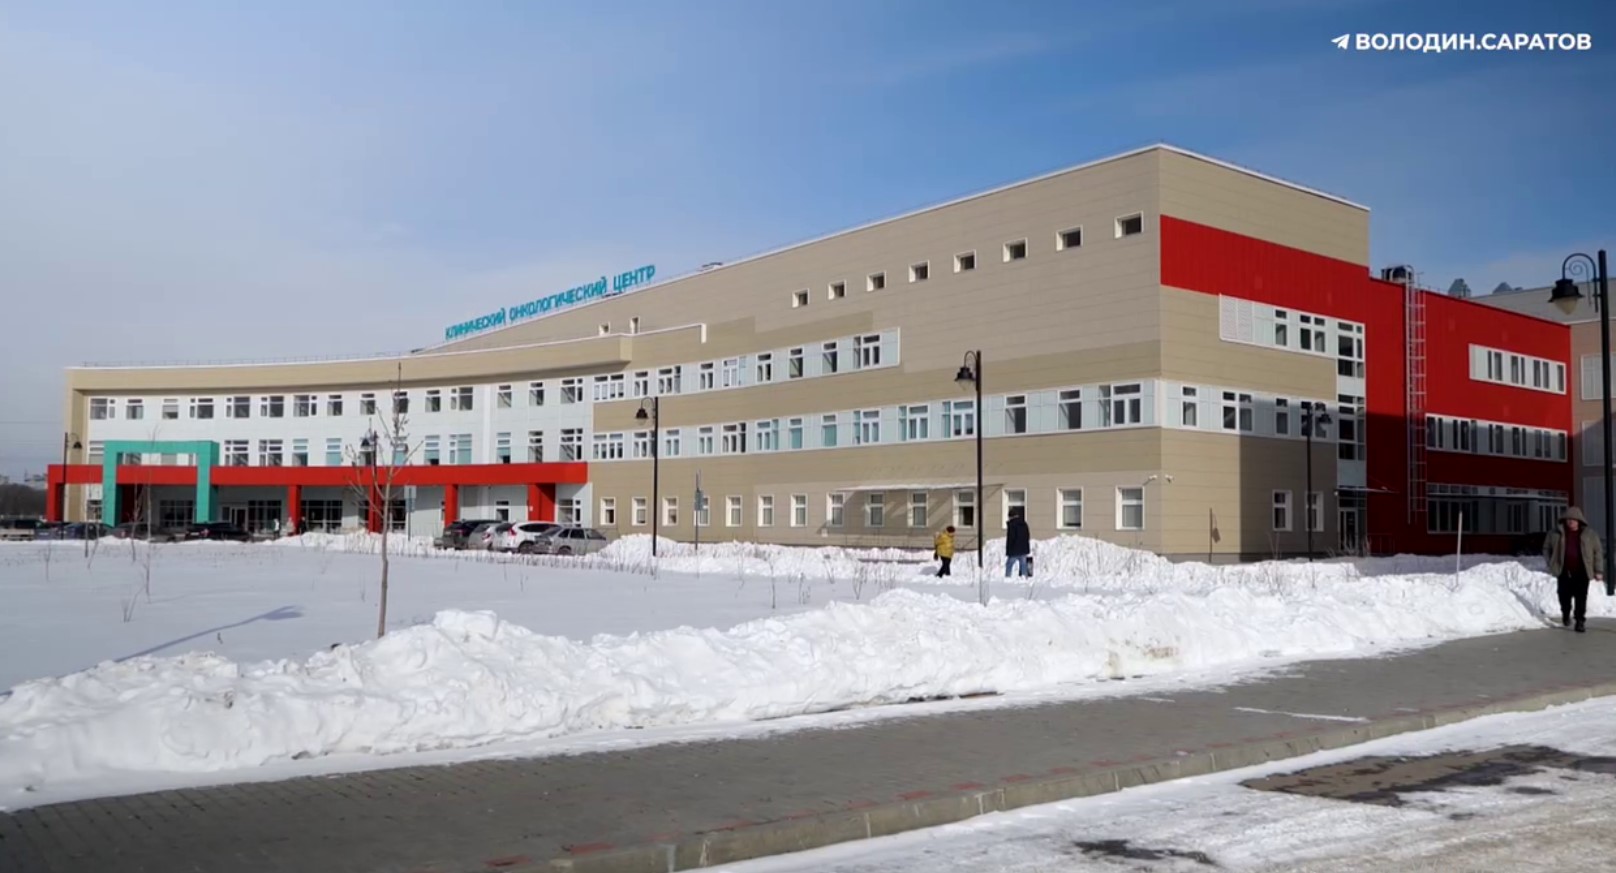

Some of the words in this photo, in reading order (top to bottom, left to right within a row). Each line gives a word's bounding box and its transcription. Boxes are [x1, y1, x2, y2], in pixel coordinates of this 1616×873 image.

[445, 308, 506, 340] КЛИНИЧЕСКИЙ
[509, 276, 607, 321] ОНКОЛОГИЧЕСКИЙ
[613, 265, 655, 294] ЦЕНТР
